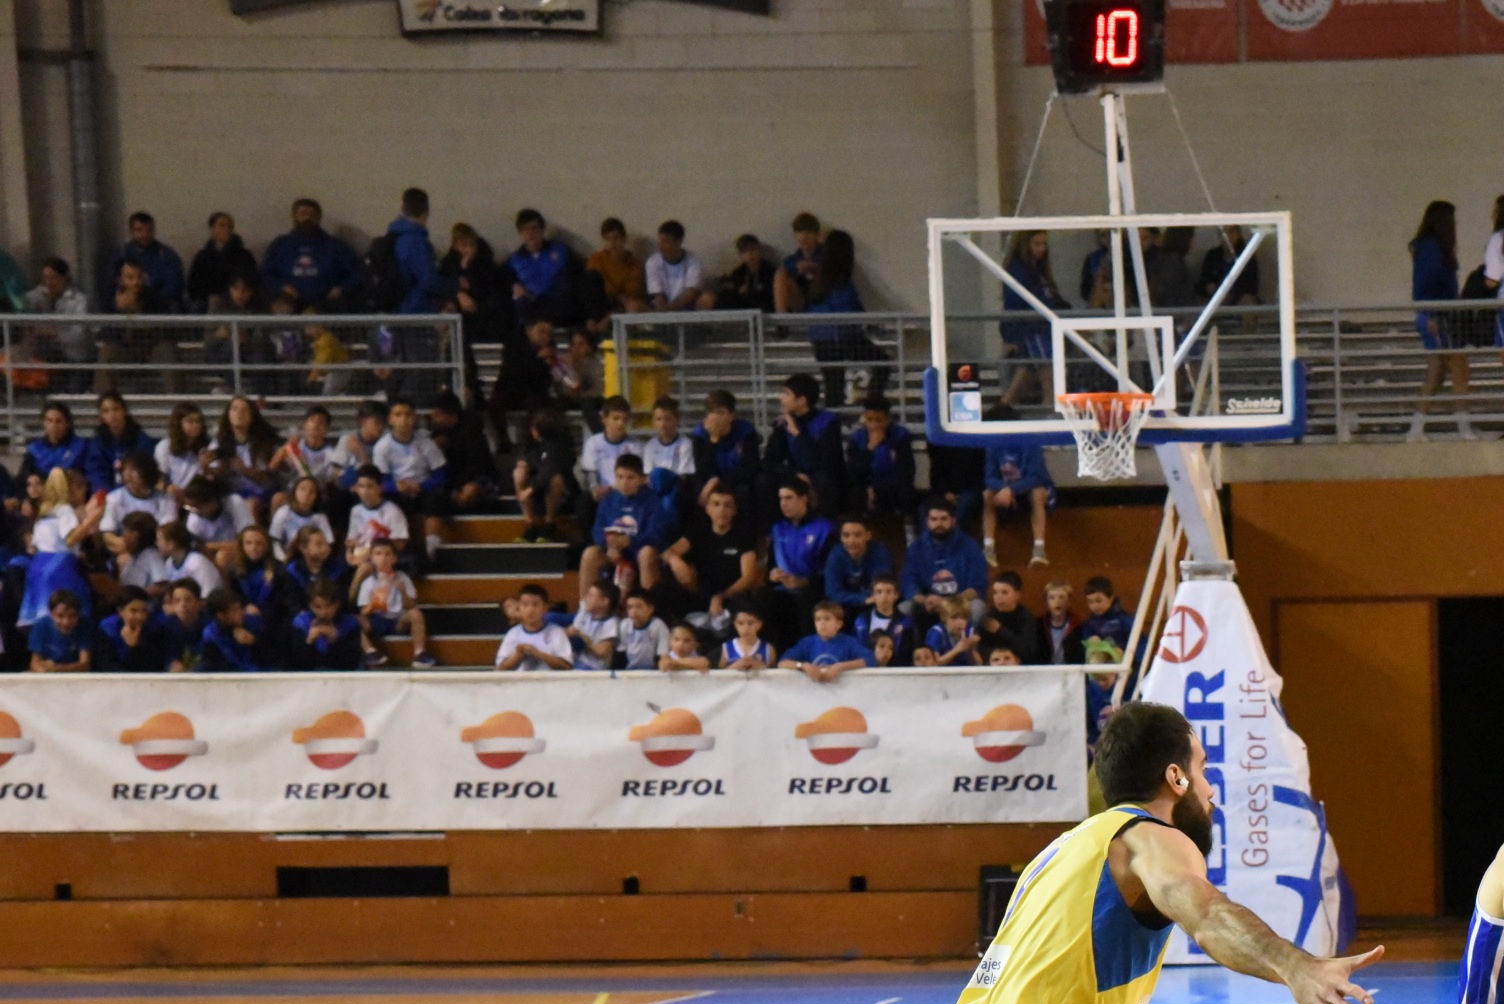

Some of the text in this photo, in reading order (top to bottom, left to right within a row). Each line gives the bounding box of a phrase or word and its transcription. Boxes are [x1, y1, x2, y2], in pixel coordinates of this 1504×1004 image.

[1095, 10, 1138, 66] 10
[1238, 669, 1270, 868] Gases for Life
[0, 783, 48, 800] SOL
[112, 783, 220, 800] REPSOL
[285, 782, 391, 799] REPSOL
[454, 781, 558, 798] REPSOL
[621, 779, 726, 796] REPSOL
[788, 777, 892, 794] REPSOL
[953, 774, 1058, 792] REPSOL
[980, 958, 1002, 976] ajes
[975, 972, 998, 986] Vele
